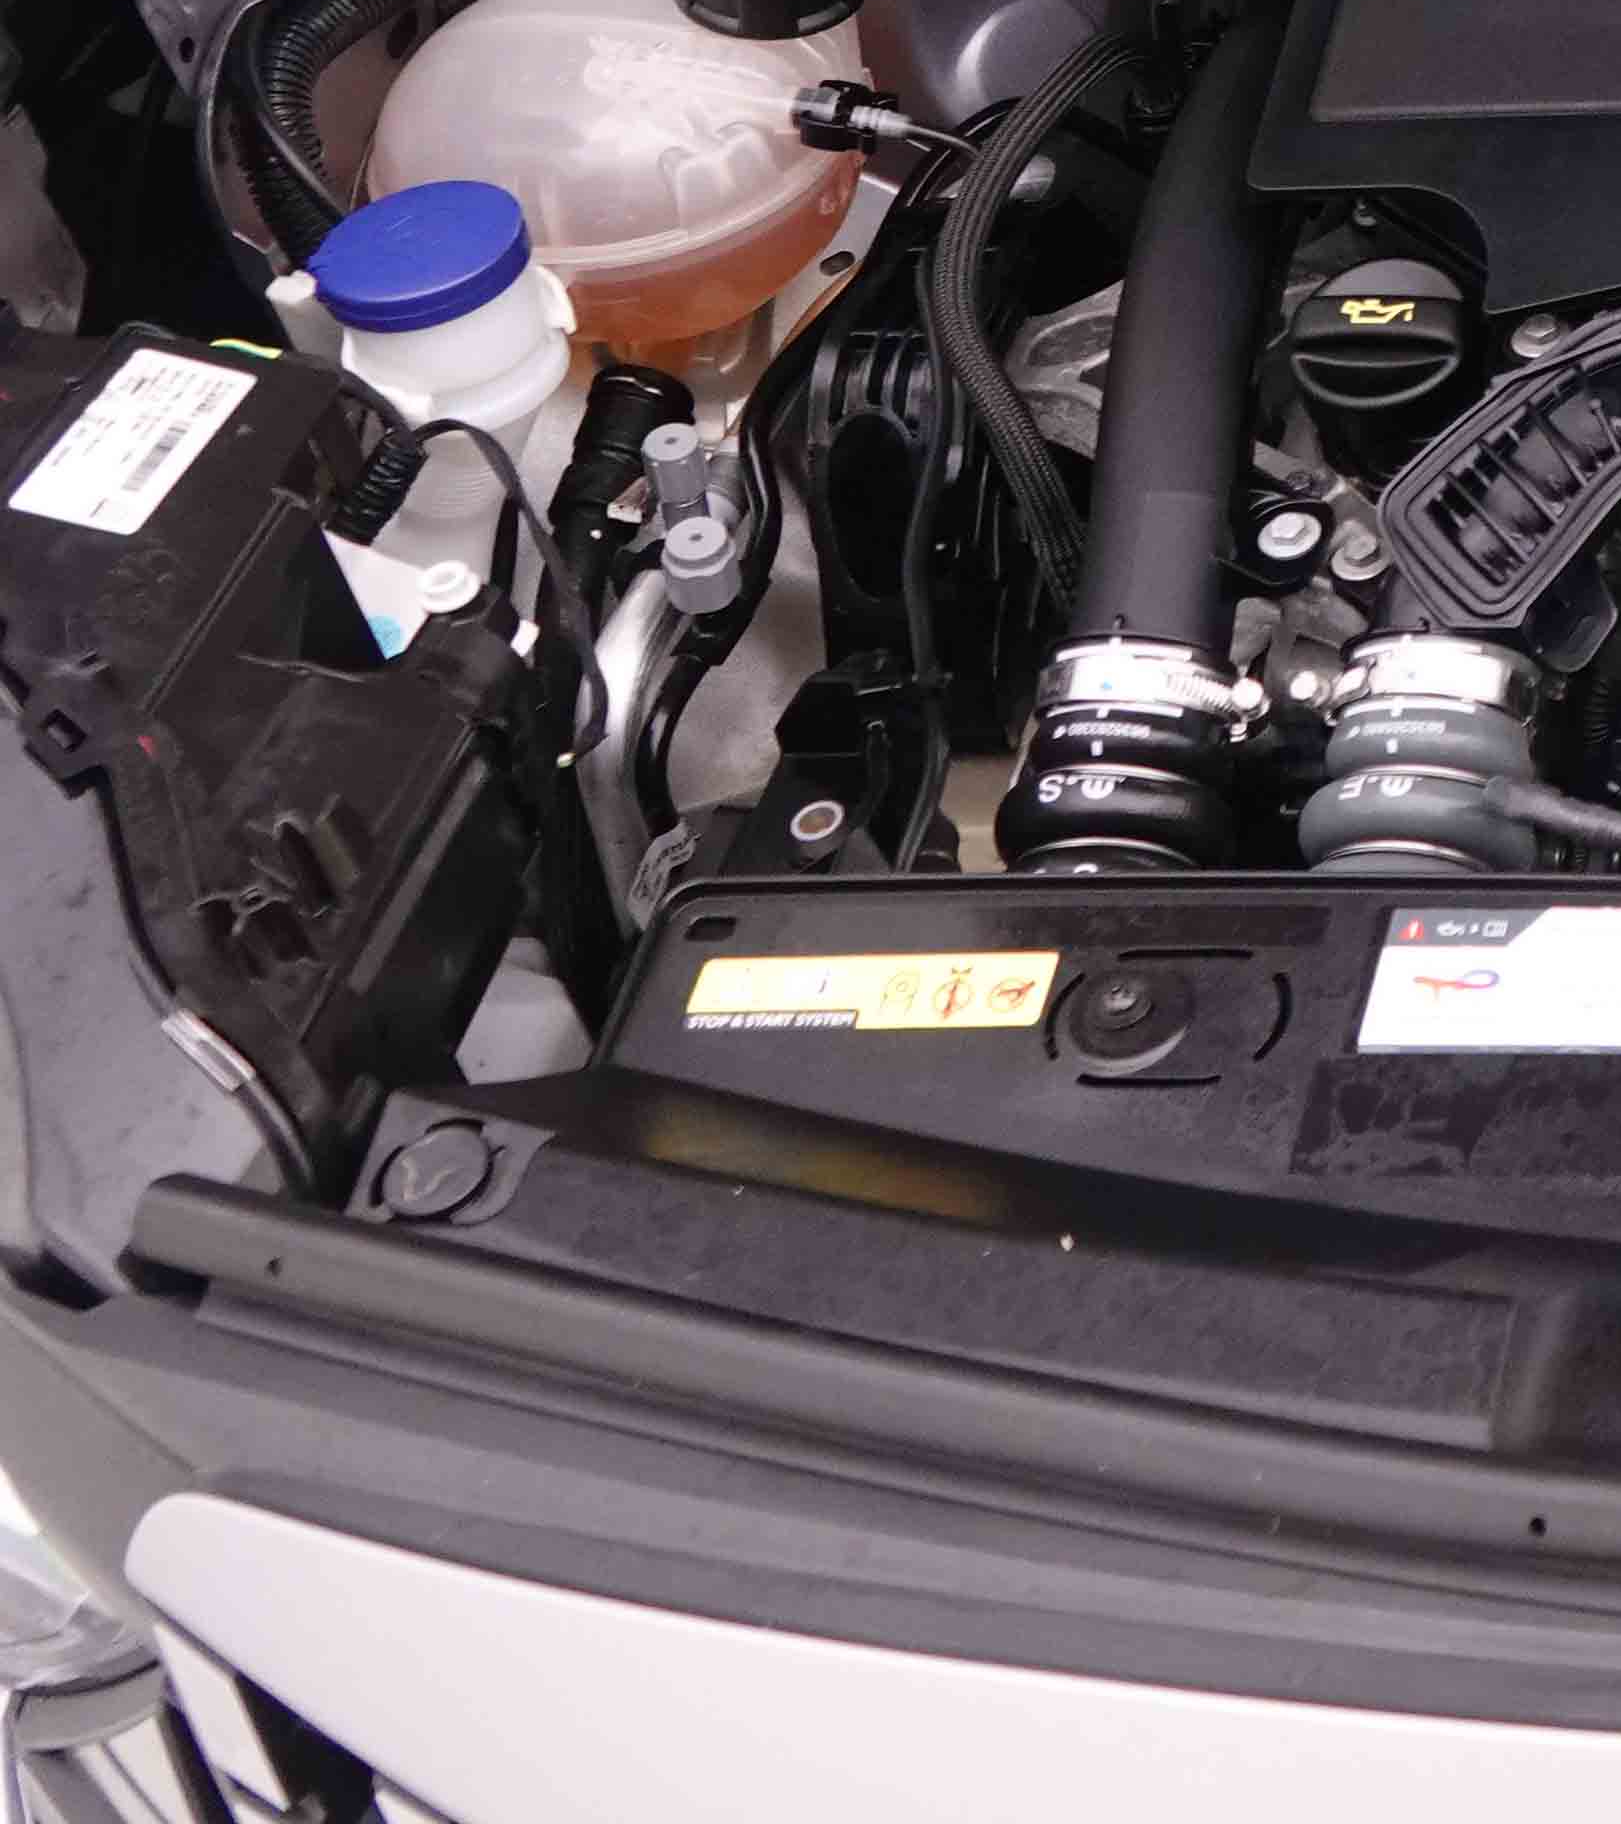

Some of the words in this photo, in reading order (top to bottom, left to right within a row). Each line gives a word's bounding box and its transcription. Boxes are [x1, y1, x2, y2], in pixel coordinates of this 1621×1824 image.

[687, 1014, 730, 1030] STOP
[745, 1013, 796, 1029] START
[795, 1012, 856, 1028] SYSTEM
